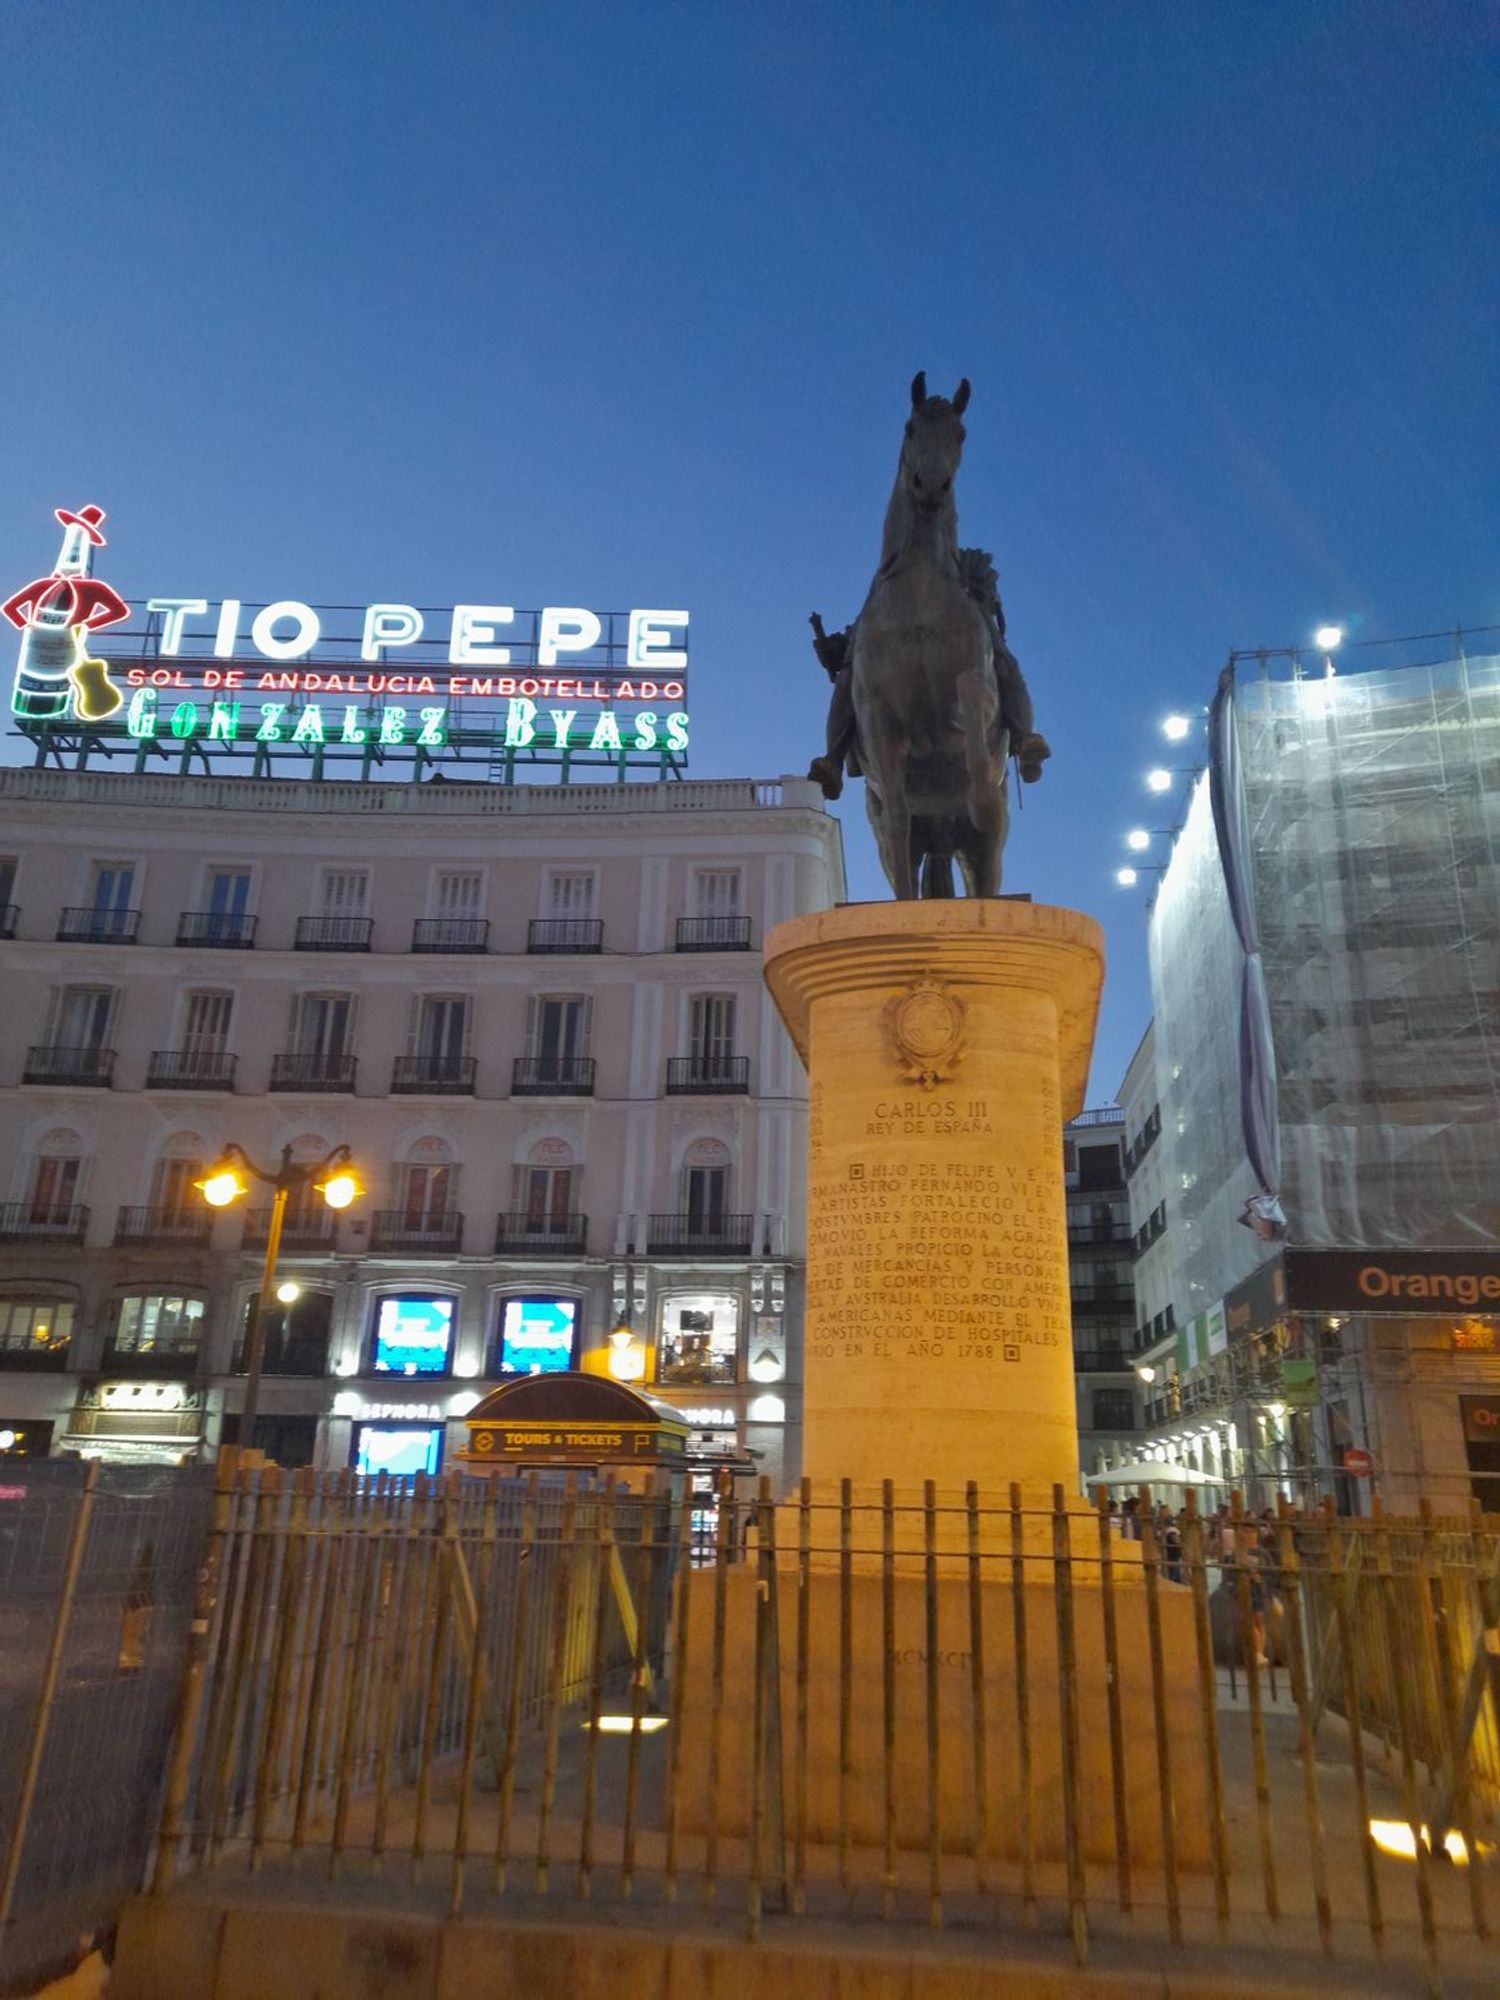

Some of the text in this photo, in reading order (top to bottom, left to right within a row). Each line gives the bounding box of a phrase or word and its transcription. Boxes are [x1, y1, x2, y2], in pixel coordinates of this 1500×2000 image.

[147, 598, 320, 660] TIO
[361, 603, 689, 669] PEPE
[127, 669, 684, 699] SOL DE ANDALUCIA EMBOTELLADO
[127, 687, 689, 751] GONZALEZ BYASS
[874, 1101, 987, 1118] CARLOS III
[866, 1118, 993, 1135] REY DE ESPAÑA
[872, 1164, 908, 1177] HIJO
[919, 1163, 937, 1176] DE
[946, 1164, 996, 1178] FELIPE
[1006, 1166, 1017, 1178] V
[809, 1179, 900, 1198] RMANASTRO
[910, 1179, 1000, 1194] FERNANDO
[820, 1195, 887, 1211] ARTISTAS
[900, 1194, 1014, 1210] FORTALECIO
[913, 1210, 1003, 1226] PATROCINO
[1013, 1214, 1030, 1227] EL
[879, 1228, 898, 1241] LA
[910, 1227, 989, 1241] REFORMA
[896, 1242, 974, 1257] PROPICIO
[982, 1244, 1002, 1258] LA
[826, 1262, 843, 1275] DE
[853, 1258, 953, 1273] MERCANCIAS
[964, 1259, 975, 1273] Y
[854, 1276, 872, 1289] DE
[882, 1275, 971, 1289] COMERCIO
[981, 1277, 1014, 1291] CON
[1359, 1266, 1500, 1304] Orange
[933, 1293, 1030, 1308] DESARROLLO
[818, 1308, 912, 1323] AMERICANAS
[924, 1309, 1006, 1325] MEDIANTE
[1015, 1312, 1032, 1327] EL
[814, 1325, 1058, 1347] CONSTRVCCION DE HOSPITALES
[845, 1343, 863, 1357] EN
[873, 1342, 892, 1357] EL
[906, 1340, 944, 1357] AÑO
[958, 1344, 994, 1358] 1788
[680, 1408, 735, 1424] HORA
[505, 1433, 551, 1445] TOURS
[566, 1433, 622, 1446] TICKETS
